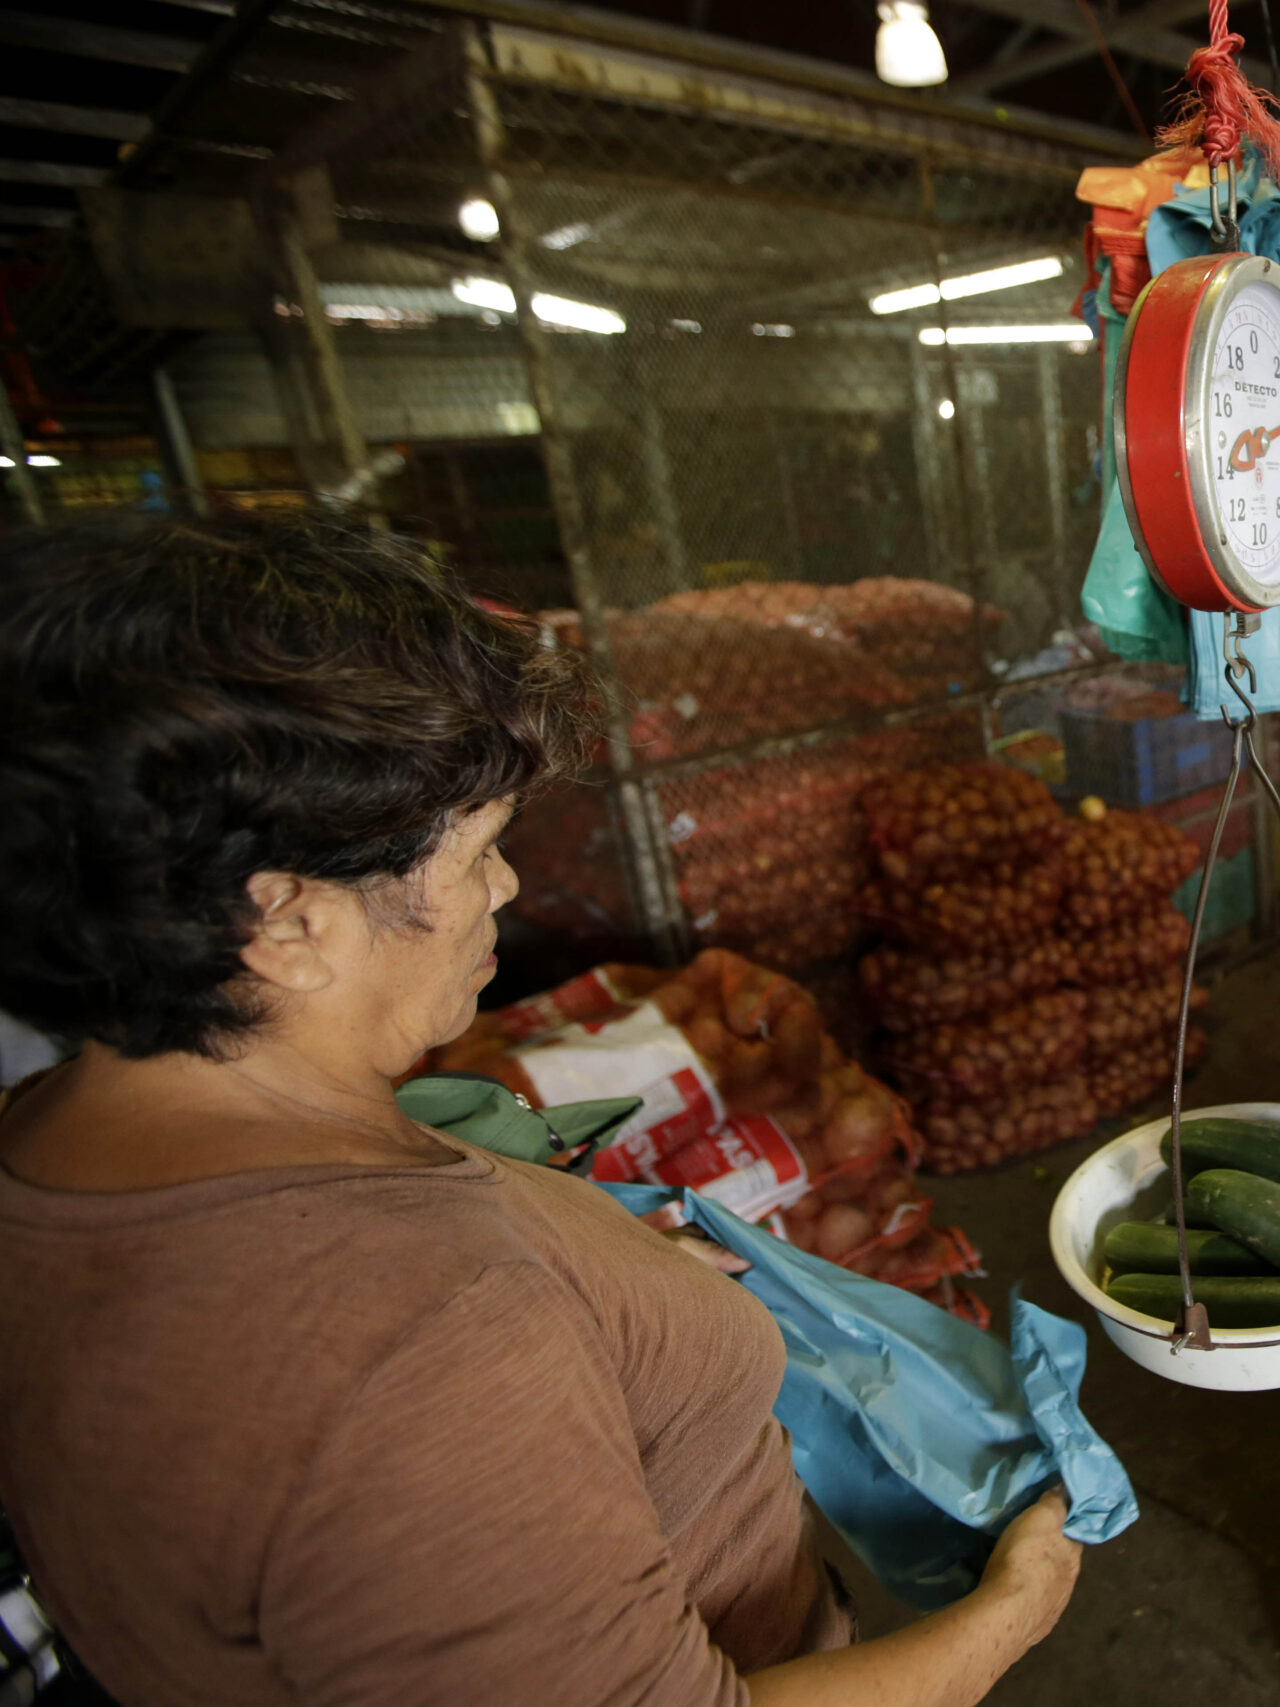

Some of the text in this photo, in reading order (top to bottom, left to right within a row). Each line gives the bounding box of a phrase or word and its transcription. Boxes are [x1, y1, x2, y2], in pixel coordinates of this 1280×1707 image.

[1250, 330, 1258, 354] 0
[1227, 345, 1244, 371] 18
[1273, 356, 1280, 379] 2
[1235, 381, 1277, 398] DETECTO
[1214, 392, 1233, 418] 16
[1217, 456, 1234, 480] 14
[1229, 498, 1246, 521] 12
[1252, 522, 1267, 545] 10
